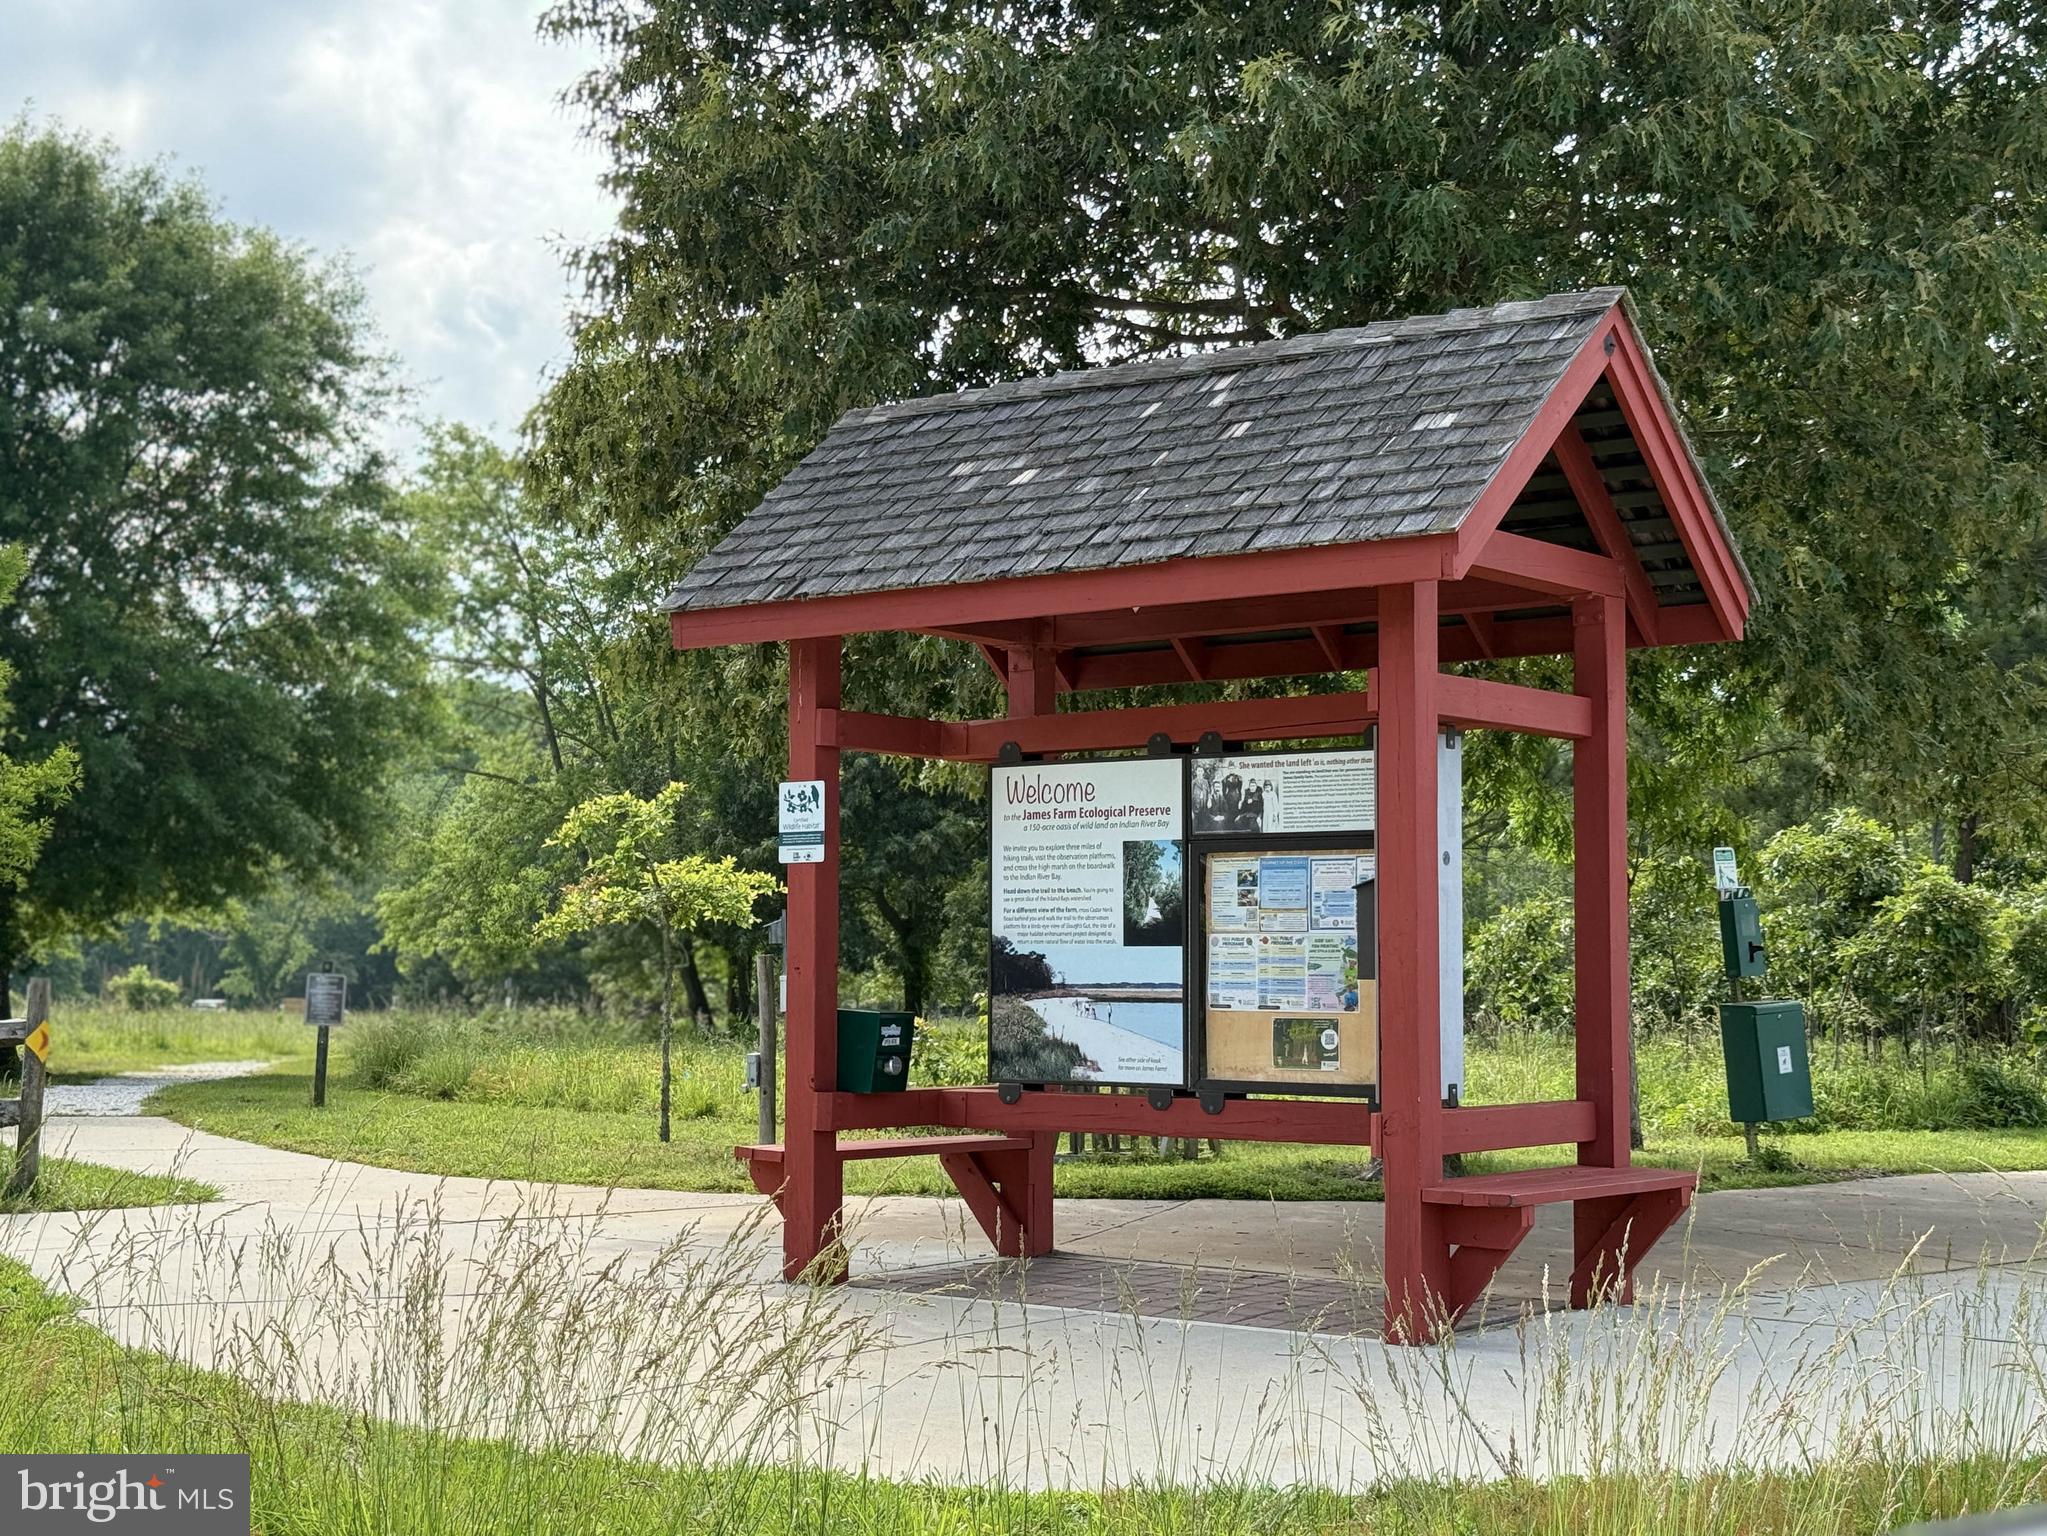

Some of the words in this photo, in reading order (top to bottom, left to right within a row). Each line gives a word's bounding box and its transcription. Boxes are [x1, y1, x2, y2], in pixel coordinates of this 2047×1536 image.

[1251, 760, 1273, 769] wanted
[1006, 774, 1096, 805] Welcome
[1022, 810, 1050, 820] James
[1054, 808, 1077, 819] Farm
[1080, 806, 1126, 821] Ecological
[1129, 805, 1171, 816] Preserve
[1073, 822, 1080, 831] of
[1080, 821, 1093, 829] wild
[1094, 821, 1108, 829] land
[1119, 820, 1140, 828] Indian
[1158, 819, 1169, 829] Bay
[1046, 844, 1065, 852] explore
[1096, 842, 1102, 850] of
